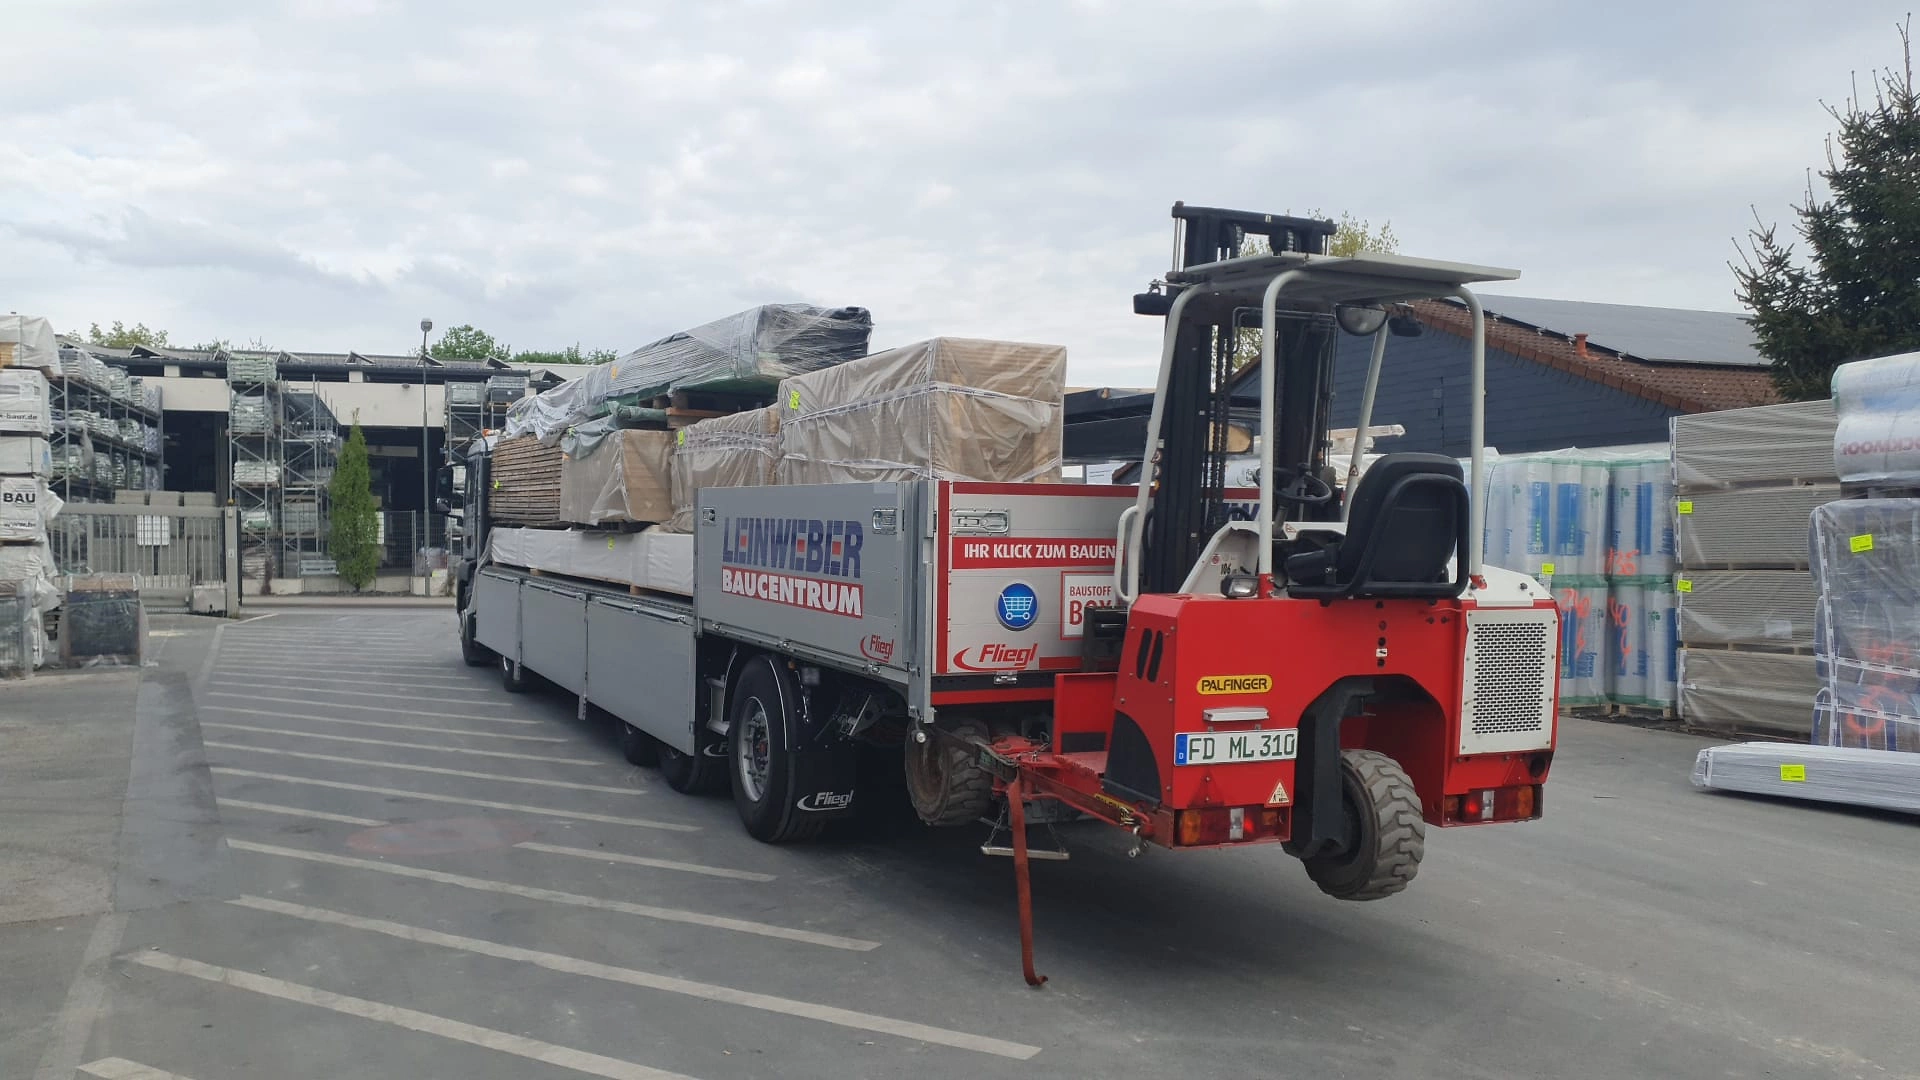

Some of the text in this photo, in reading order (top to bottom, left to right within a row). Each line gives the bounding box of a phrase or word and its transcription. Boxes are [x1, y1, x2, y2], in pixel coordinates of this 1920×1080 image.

[722, 517, 863, 578] LEINWEBER
[964, 543, 1116, 559] IHR KLICK ZUM BAUEN
[722, 569, 862, 616] BAUCENTRUM
[1070, 585, 1112, 597] BAUSTOFF
[870, 634, 895, 660] Fliegl
[978, 643, 1039, 666] Fliegl
[1201, 678, 1268, 692] PALFINGER
[1188, 733, 1296, 760] FD ML 310
[814, 789, 855, 807] Fliegl
